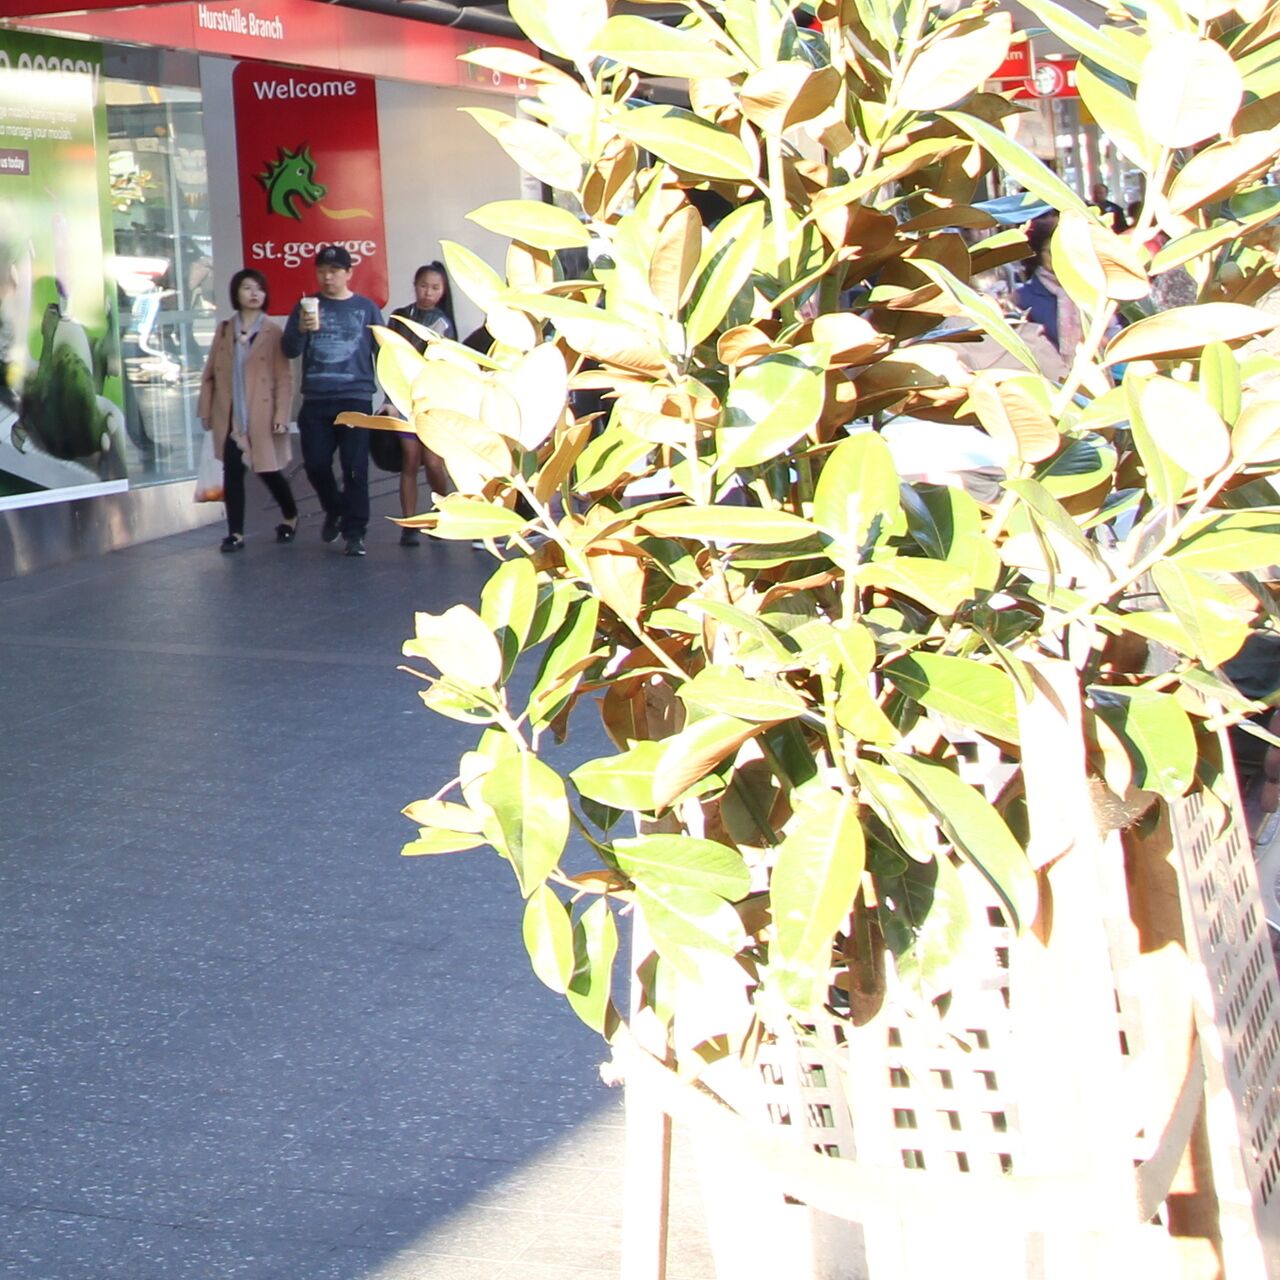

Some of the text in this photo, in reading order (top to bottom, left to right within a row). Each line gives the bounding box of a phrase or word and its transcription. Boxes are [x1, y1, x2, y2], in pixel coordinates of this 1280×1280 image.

[198, 3, 283, 39] Hurstville Branch
[253, 78, 357, 100] Welcome
[7, 156, 25, 172] today
[251, 240, 377, 268] st.gege
